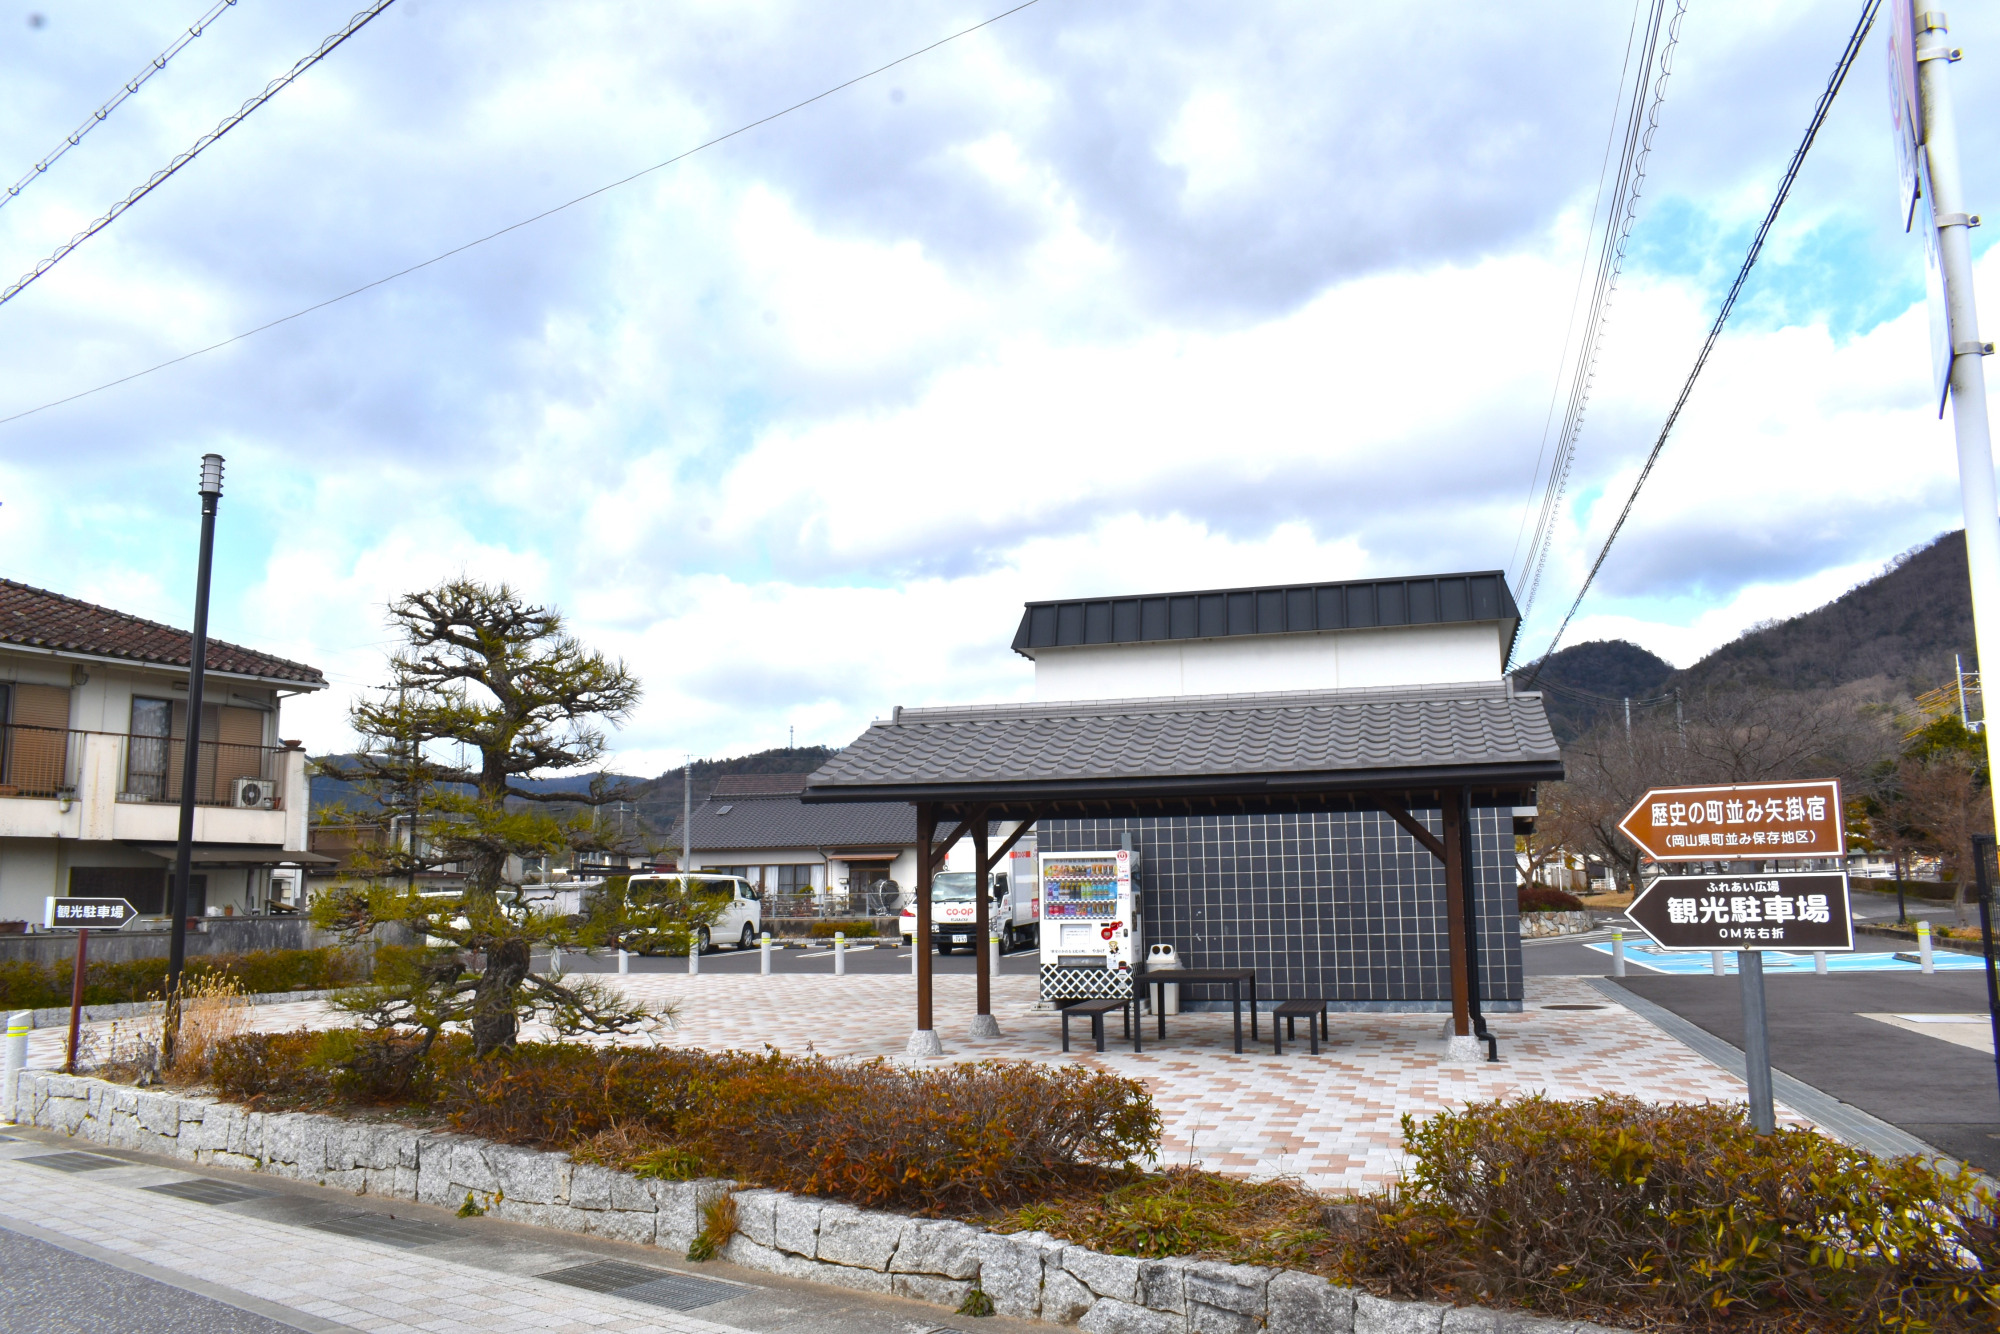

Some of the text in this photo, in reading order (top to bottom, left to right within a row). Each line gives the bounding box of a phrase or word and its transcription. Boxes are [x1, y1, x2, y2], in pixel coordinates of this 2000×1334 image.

[1651, 795, 1826, 827] 歴史の町並み矢掛宿
[1706, 880, 1780, 893] ふれあい広場
[56, 904, 124, 919] 観光駐車場
[1667, 894, 1830, 924] 観光駐車場
